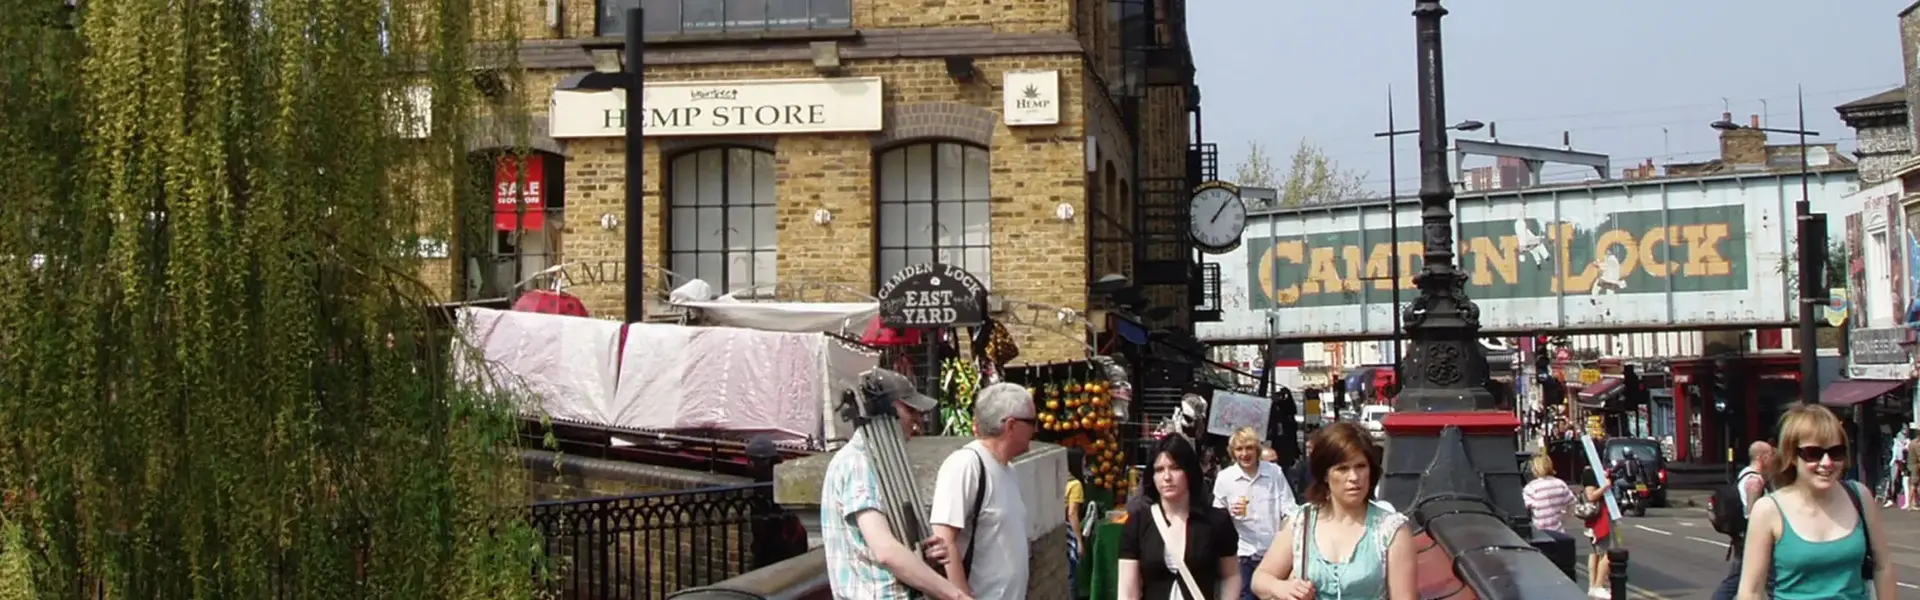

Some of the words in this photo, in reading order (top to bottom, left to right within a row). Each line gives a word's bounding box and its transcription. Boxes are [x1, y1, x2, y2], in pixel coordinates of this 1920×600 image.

[1016, 99, 1050, 108] HEMP
[603, 108, 701, 128] HMP
[712, 104, 826, 126] STORE
[498, 181, 540, 196] SALE
[1258, 235, 1520, 305] CAMDN
[1548, 222, 1731, 293] LOCK
[878, 262, 934, 300] CAMDEN
[943, 264, 981, 297] LOCK
[905, 290, 953, 307] EAST
[902, 307, 957, 324] YARD
